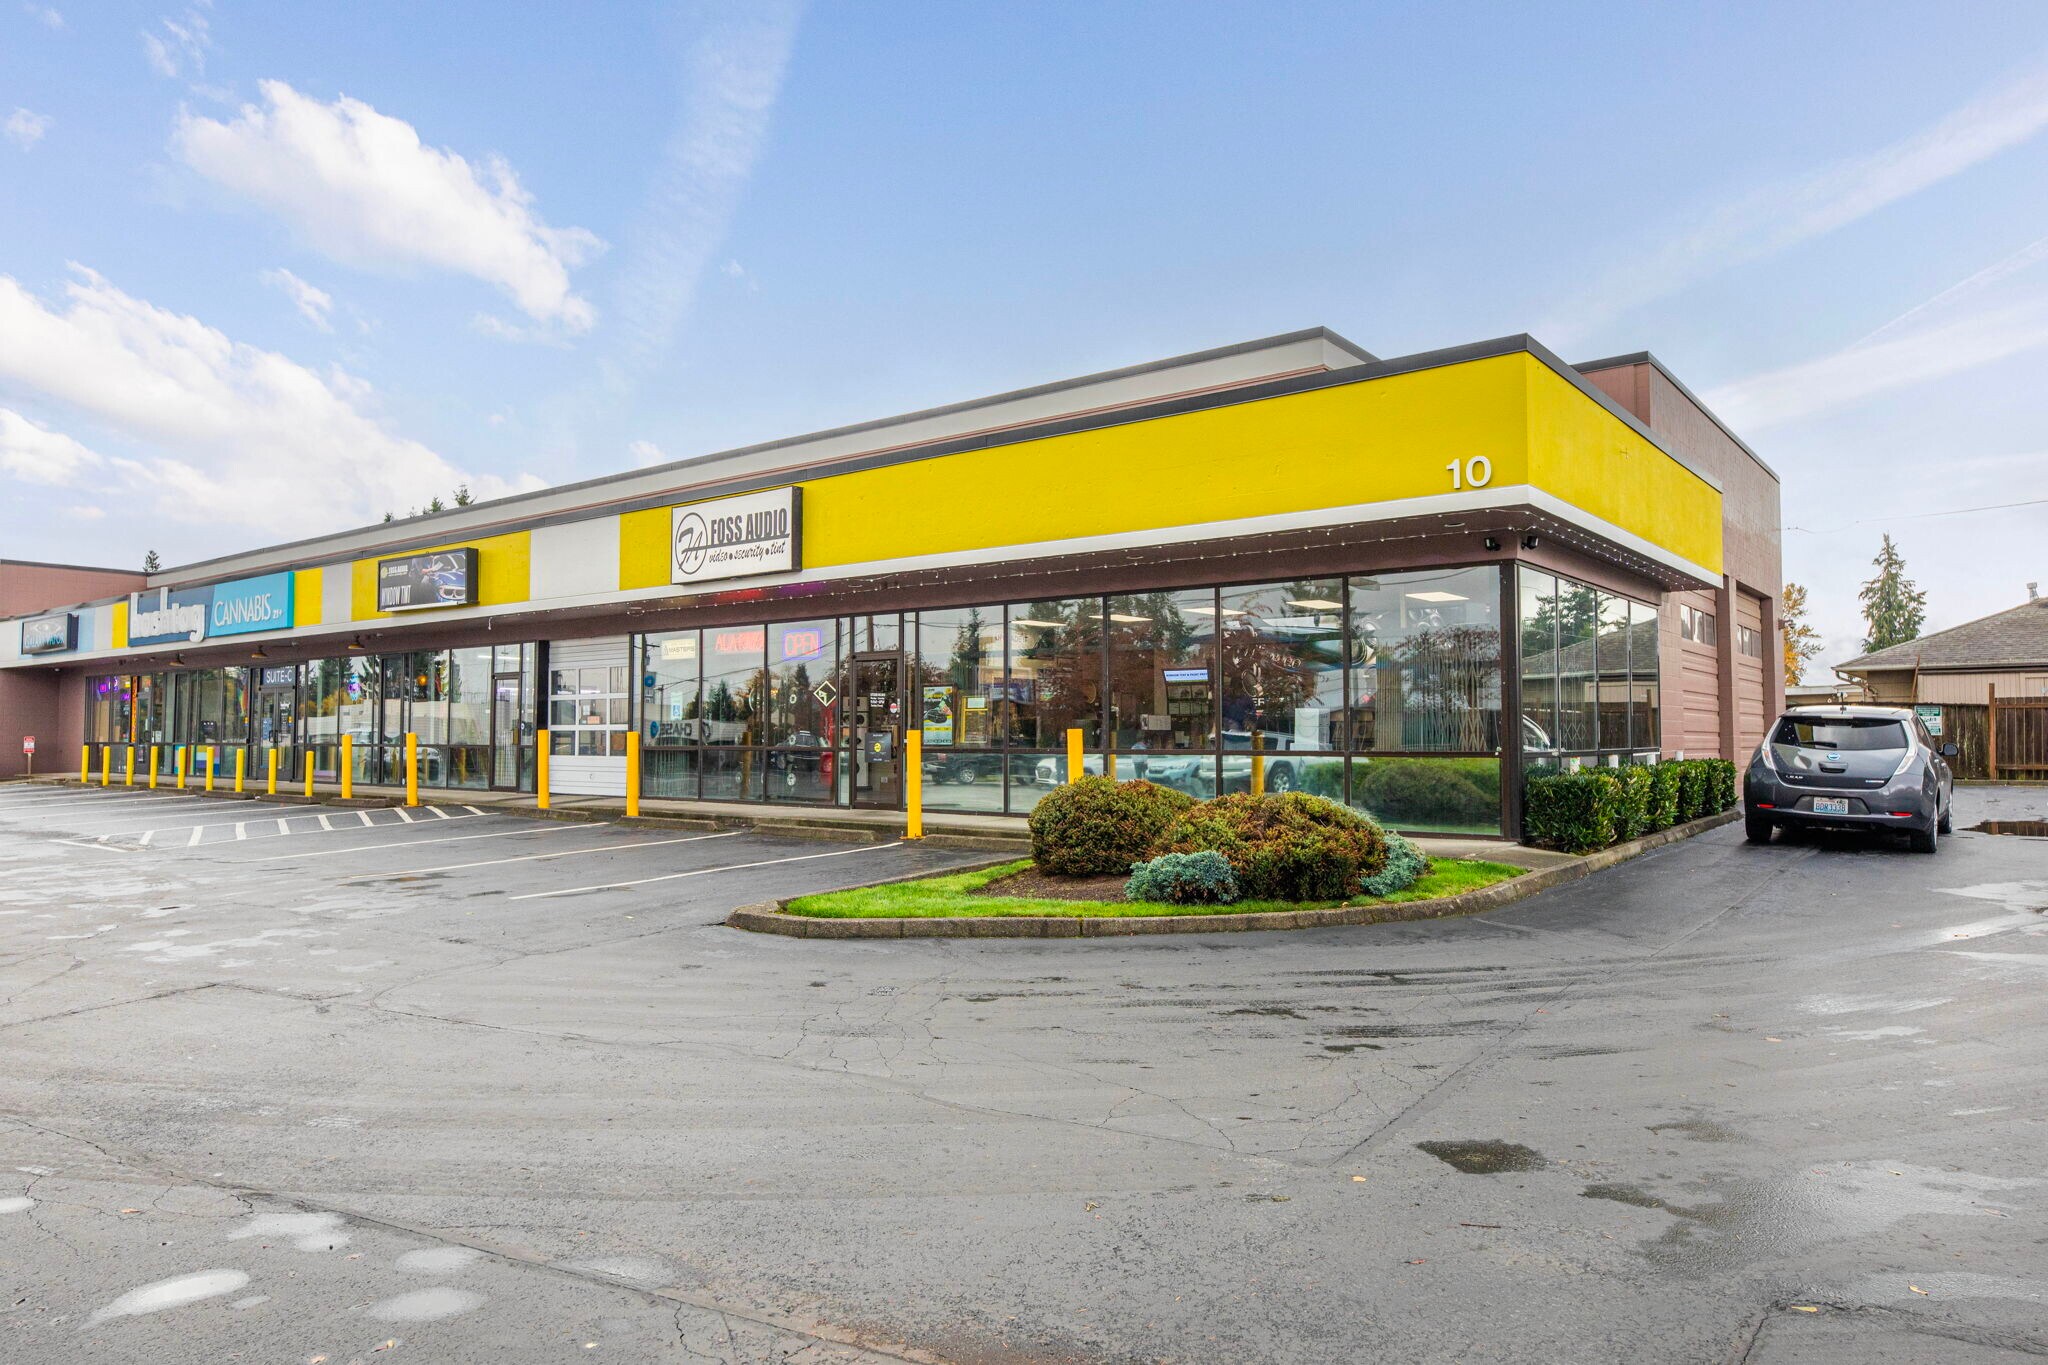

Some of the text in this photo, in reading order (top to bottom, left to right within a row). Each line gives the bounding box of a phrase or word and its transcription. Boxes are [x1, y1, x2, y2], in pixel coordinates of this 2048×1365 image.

[1446, 455, 1492, 489] 10
[710, 508, 788, 546] FOSS AUDIO
[709, 540, 786, 563] video security tint
[130, 586, 206, 643] hashtag
[214, 593, 283, 627] CANNABIS 21+
[785, 632, 819, 656] OPEN
[266, 670, 293, 683] SUITE-C
